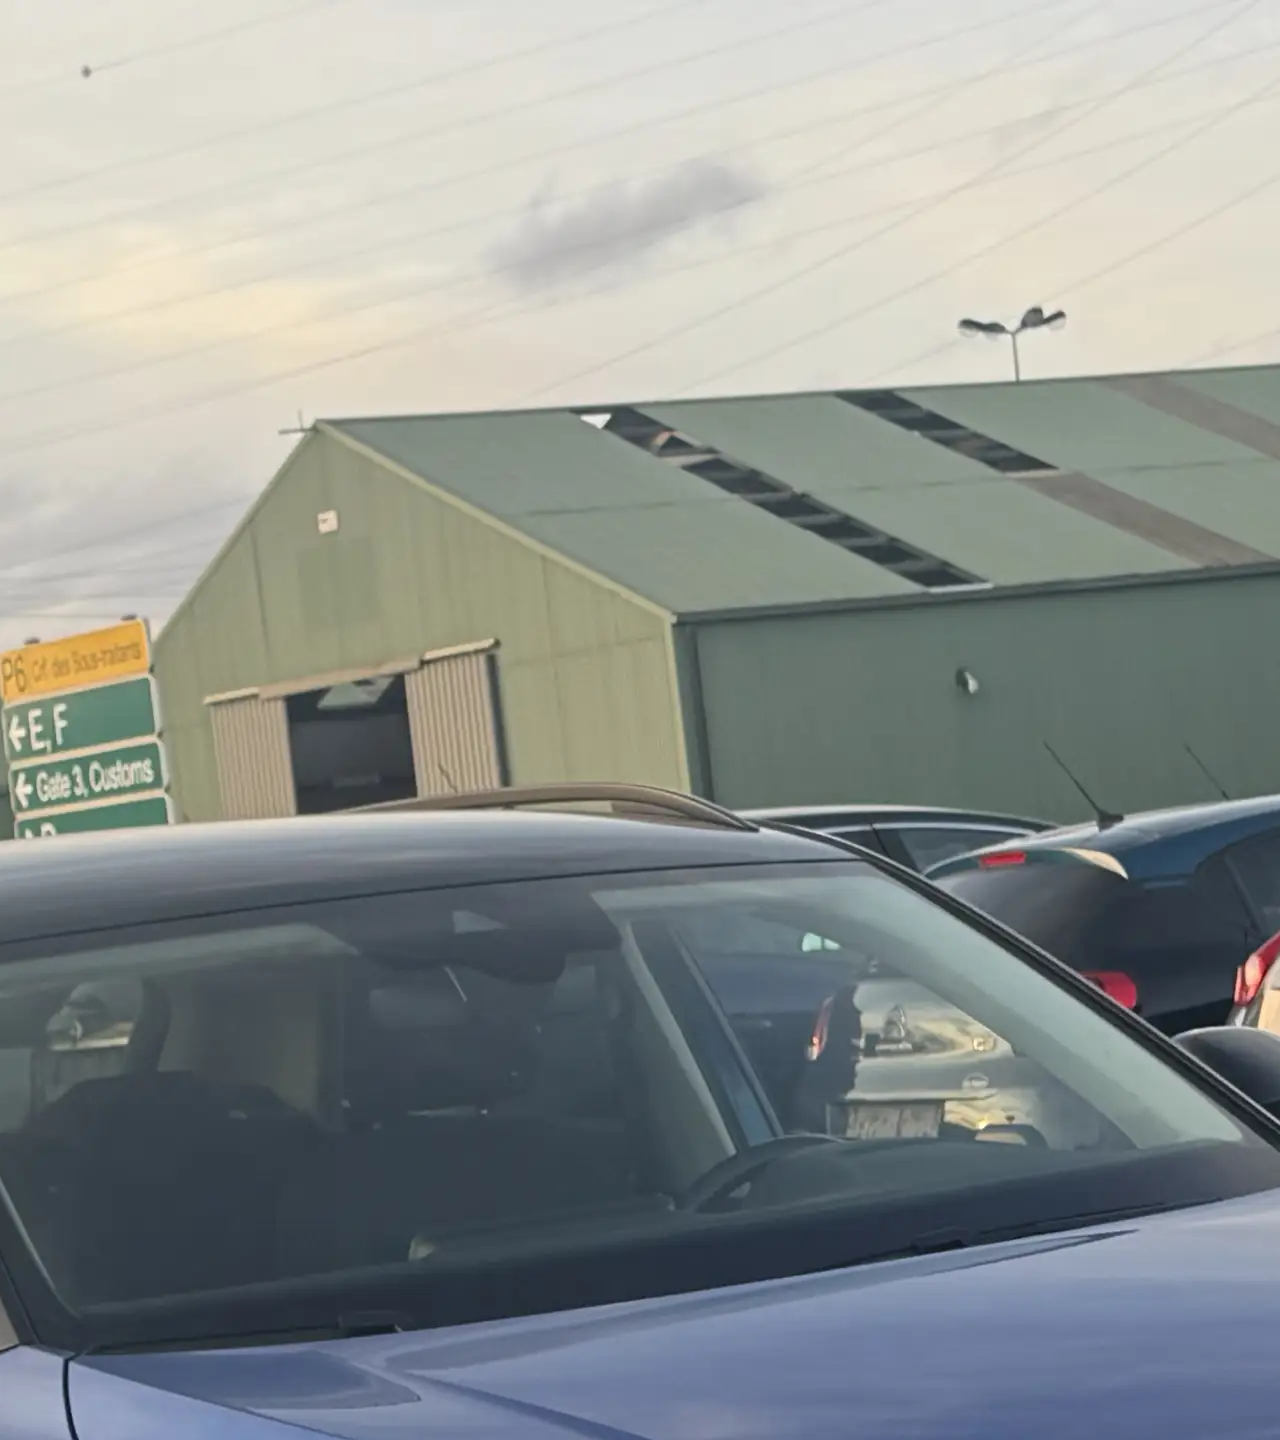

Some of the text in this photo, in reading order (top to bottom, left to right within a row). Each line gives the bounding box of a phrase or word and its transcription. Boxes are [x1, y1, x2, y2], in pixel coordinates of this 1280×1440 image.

[1, 655, 28, 695] P6
[28, 703, 68, 753] E, F
[36, 769, 72, 802] Gate
[89, 758, 154, 793] Customs
